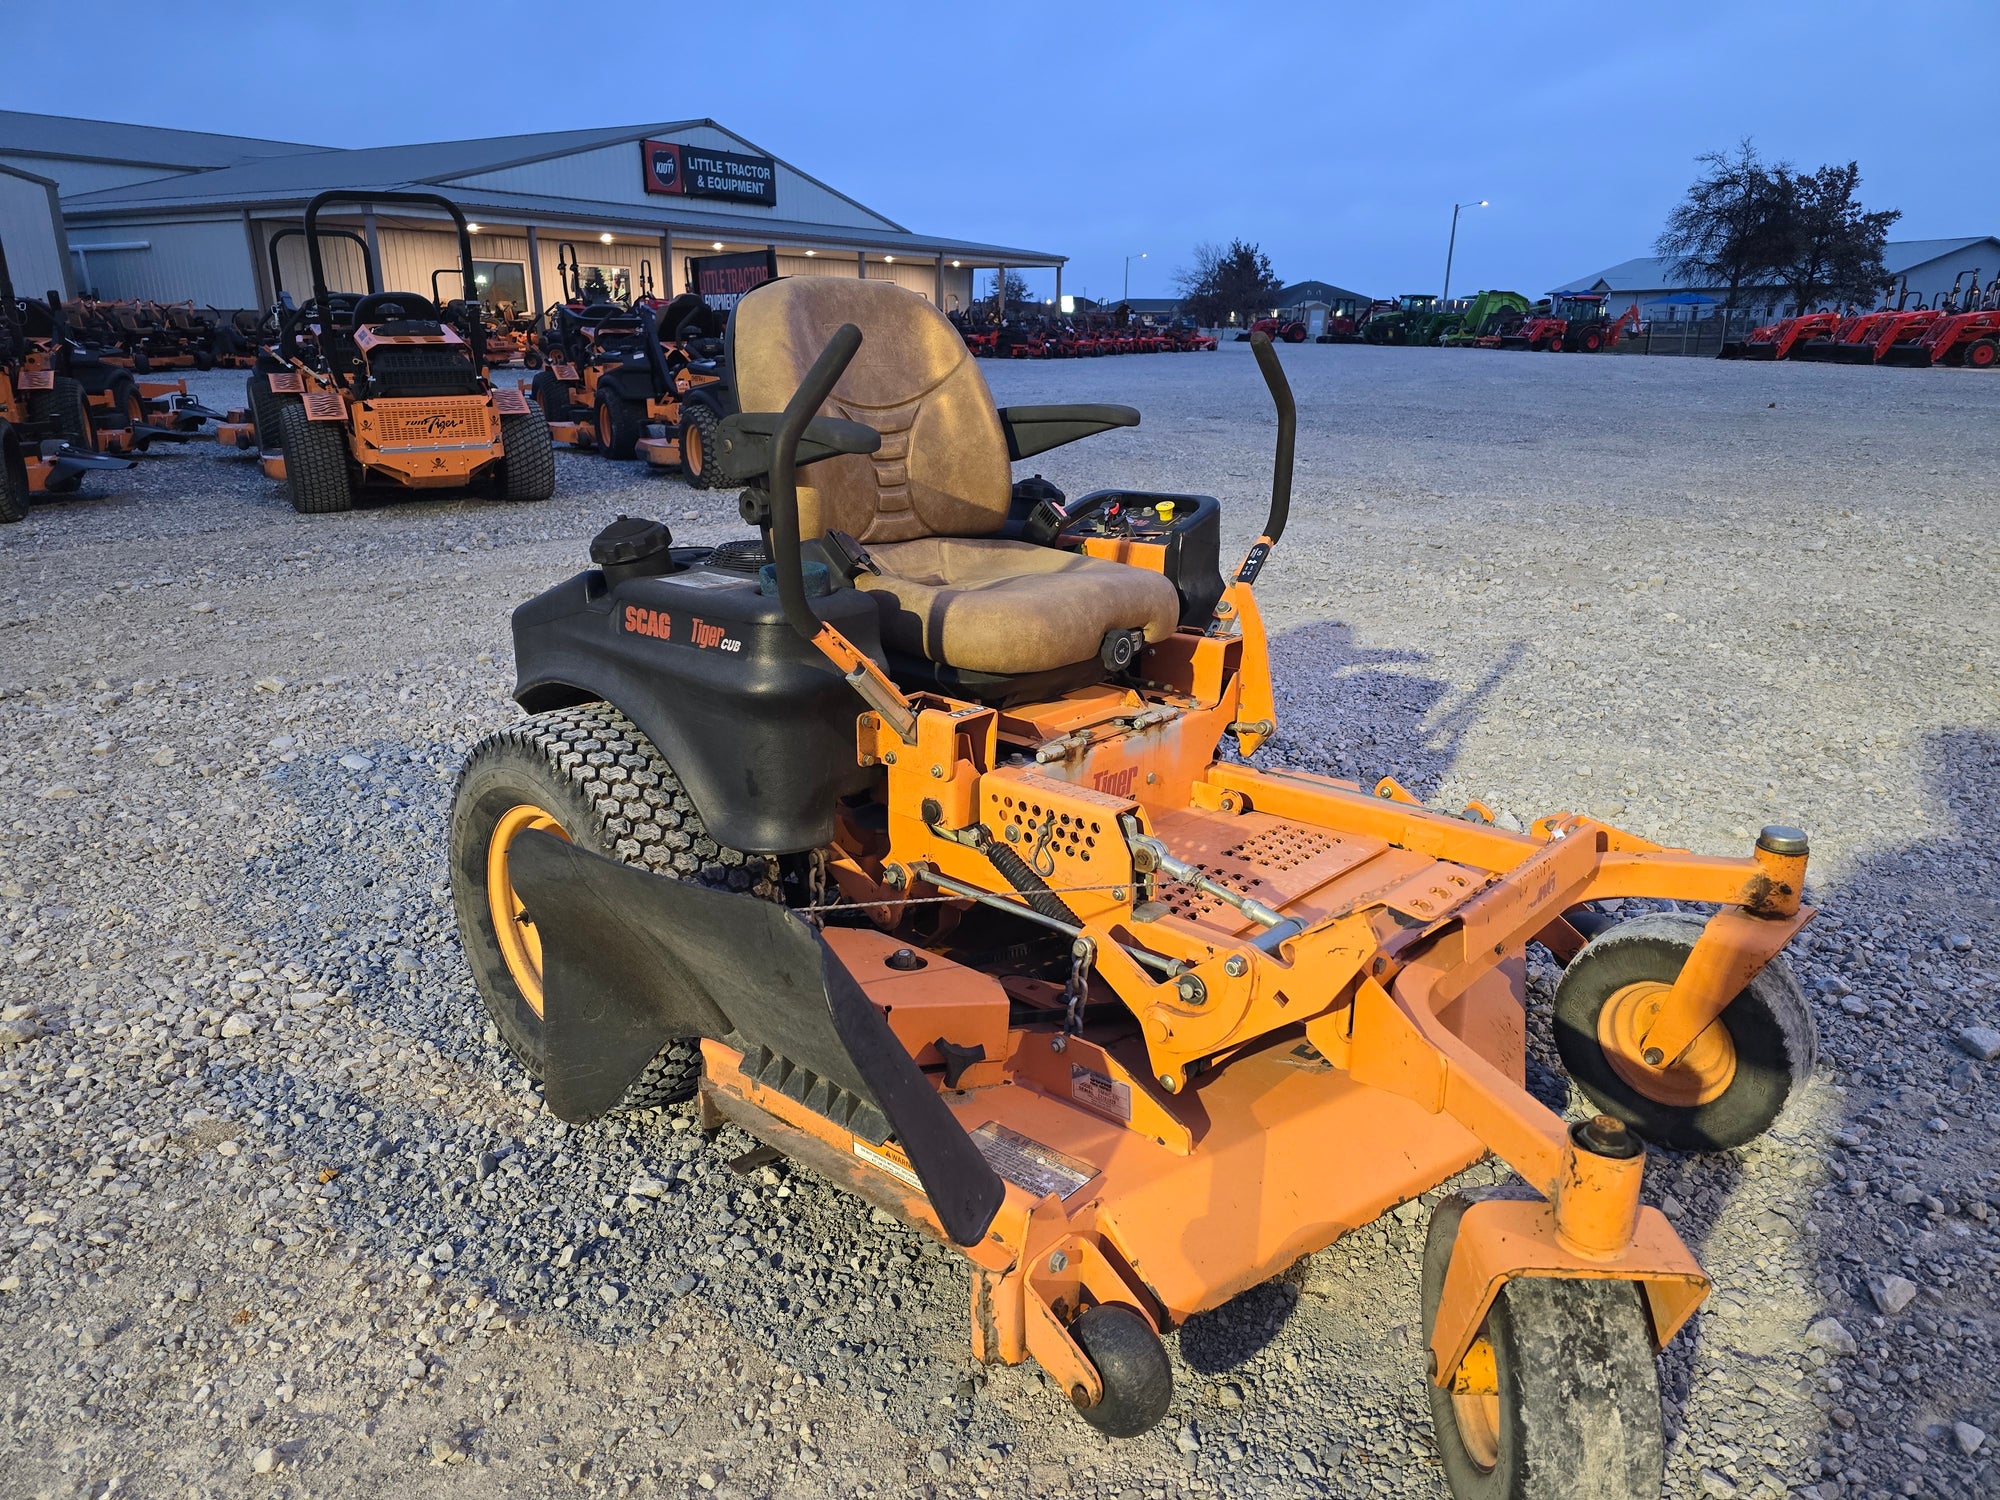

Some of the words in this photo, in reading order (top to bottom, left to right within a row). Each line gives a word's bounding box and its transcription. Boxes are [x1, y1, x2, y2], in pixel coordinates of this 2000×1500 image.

[688, 157, 723, 174] LITTLE
[725, 162, 771, 180] TRACTOR
[697, 175, 704, 188] &
[708, 177, 764, 195] EQUIPMENT
[699, 270, 725, 293] LITTLE
[725, 266, 768, 292] TRACTOR
[424, 414, 458, 434] Tiger
[625, 605, 671, 640] SCAG
[691, 617, 725, 649] Tiger
[720, 638, 742, 652] CUB
[1023, 1139, 1064, 1161] WARNING
